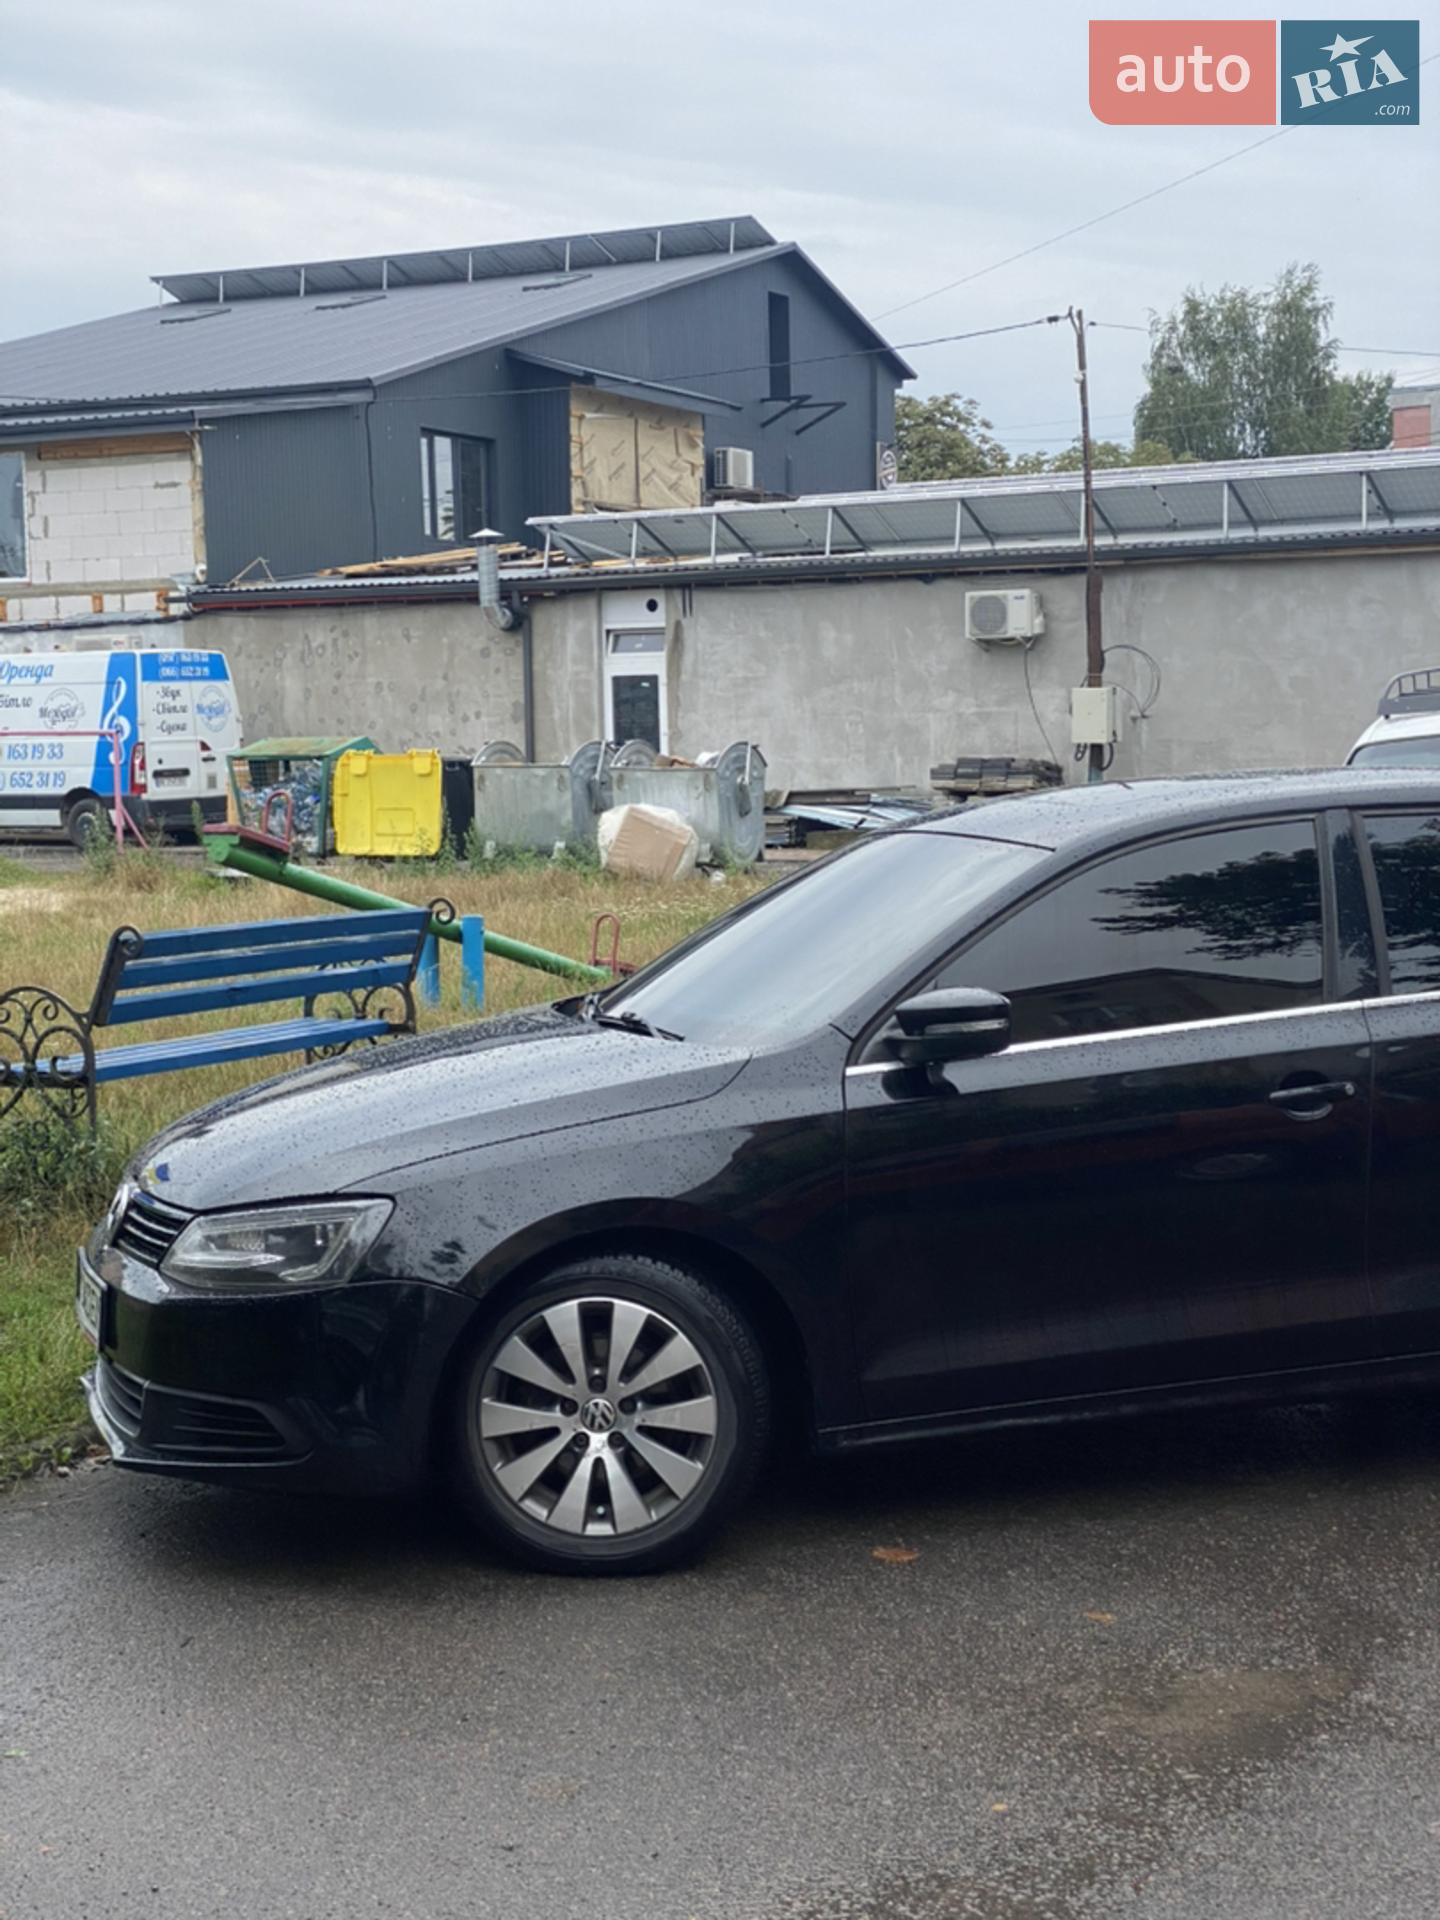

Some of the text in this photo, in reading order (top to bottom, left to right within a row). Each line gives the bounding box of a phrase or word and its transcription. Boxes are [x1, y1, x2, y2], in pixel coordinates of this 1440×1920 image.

[7, 743, 64, 760] 163 19 33
[10, 771, 33, 788] 652
[36, 771, 50, 788] 31
[53, 771, 66, 788] 19
